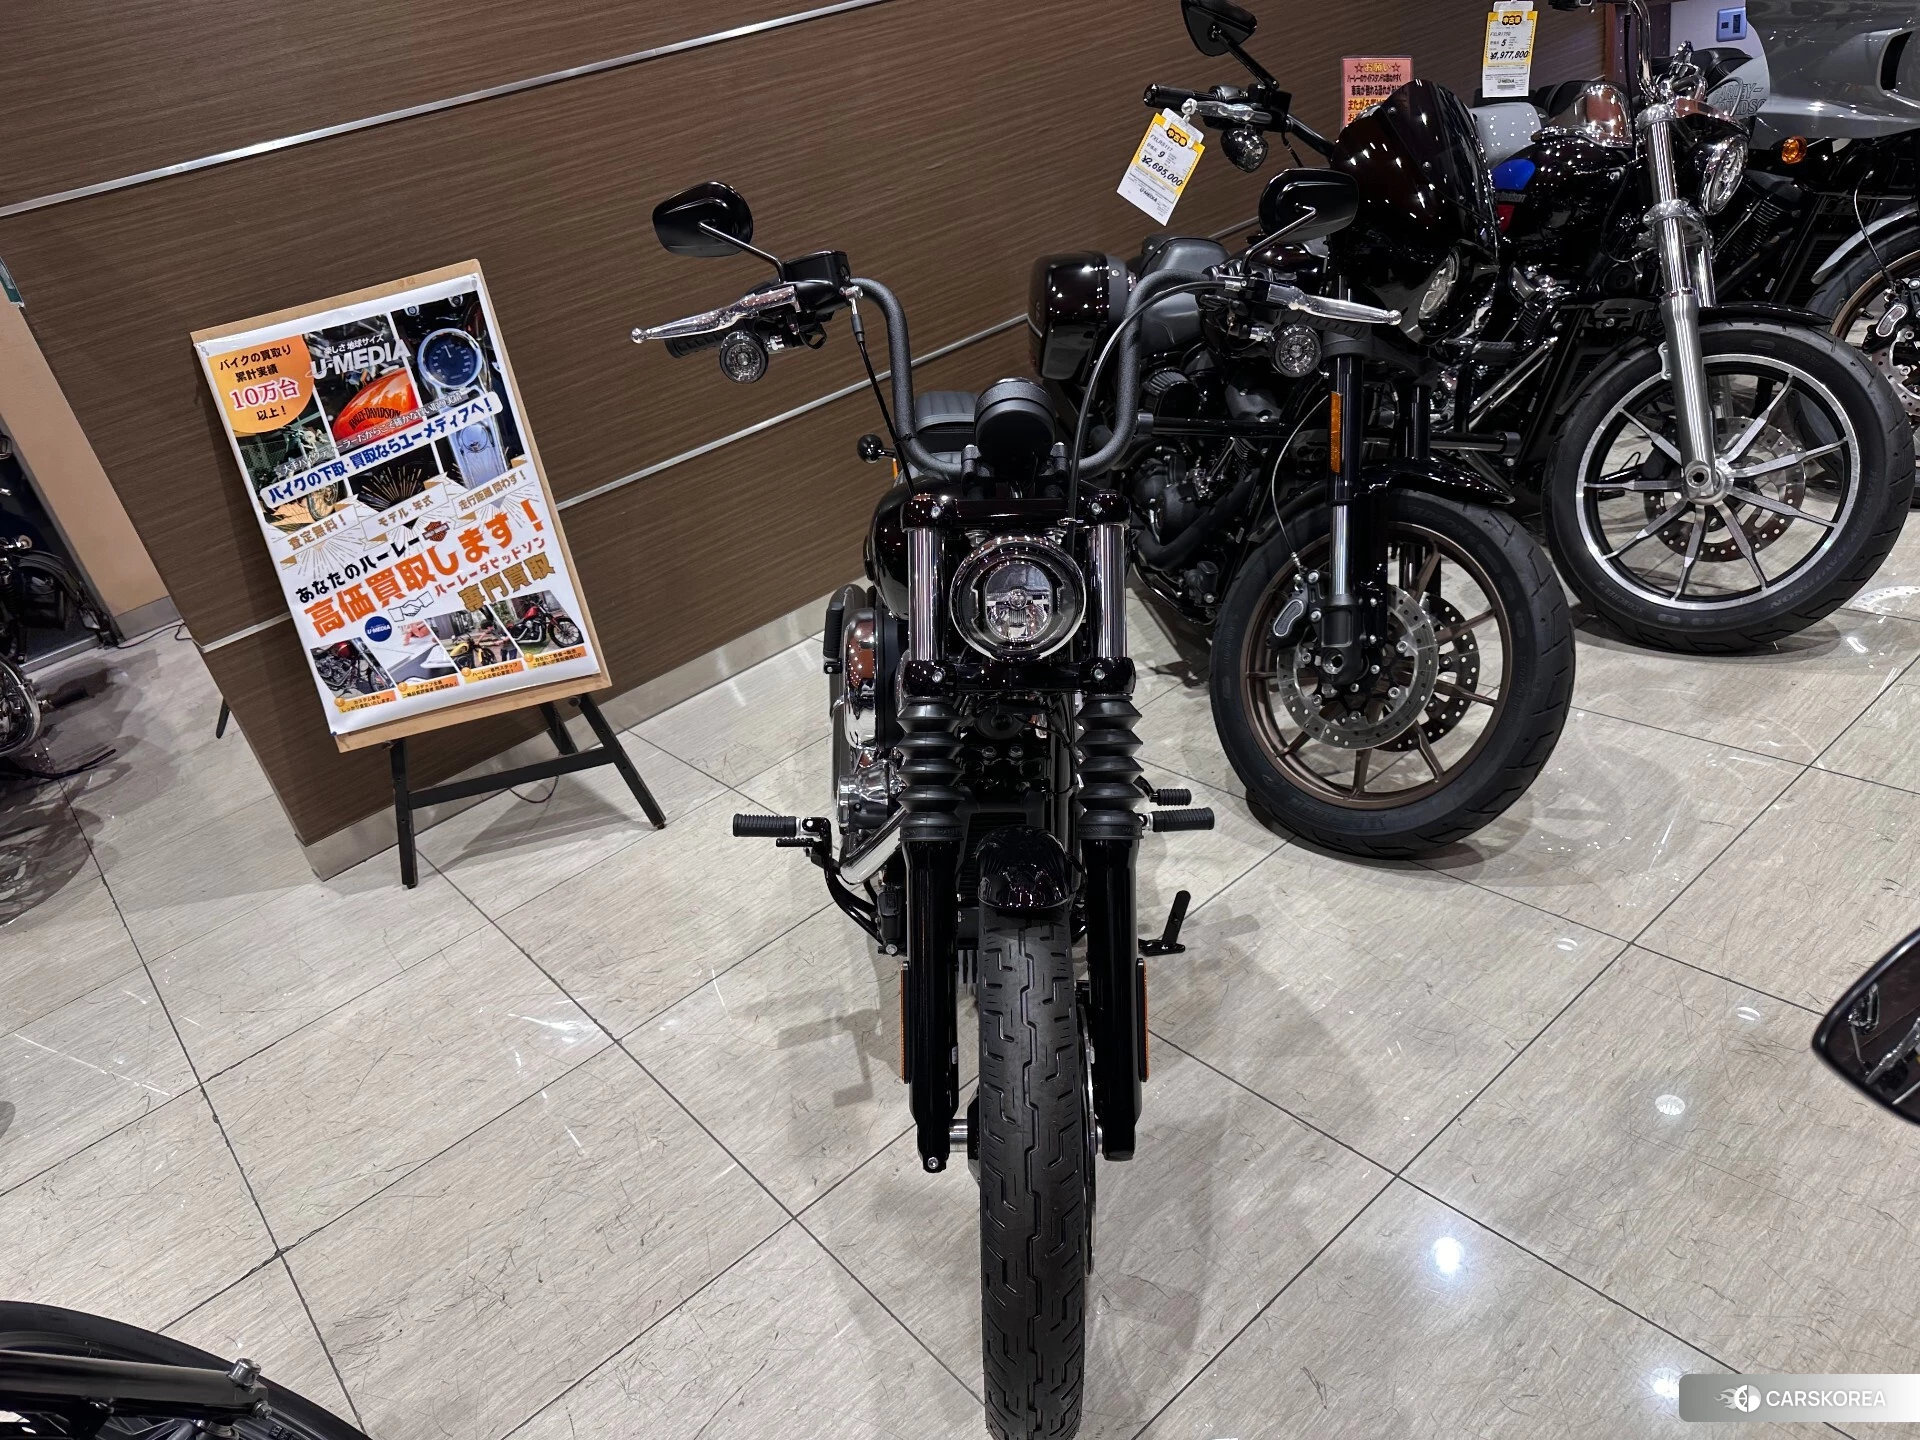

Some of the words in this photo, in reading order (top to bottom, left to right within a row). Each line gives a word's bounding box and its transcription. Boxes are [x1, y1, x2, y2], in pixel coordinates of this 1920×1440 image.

[1501, 39, 1507, 47] 5
[1158, 150, 1166, 158] 9
[1141, 154, 1184, 187] ¥2,695,000
[220, 344, 291, 370] バイクの買取り
[235, 363, 279, 383] 累計実績
[231, 378, 299, 410] 10万台
[296, 535, 421, 604] あなたのハーレー
[435, 538, 547, 597] ハーレーダビッドソン
[457, 552, 555, 613] 専門買取
